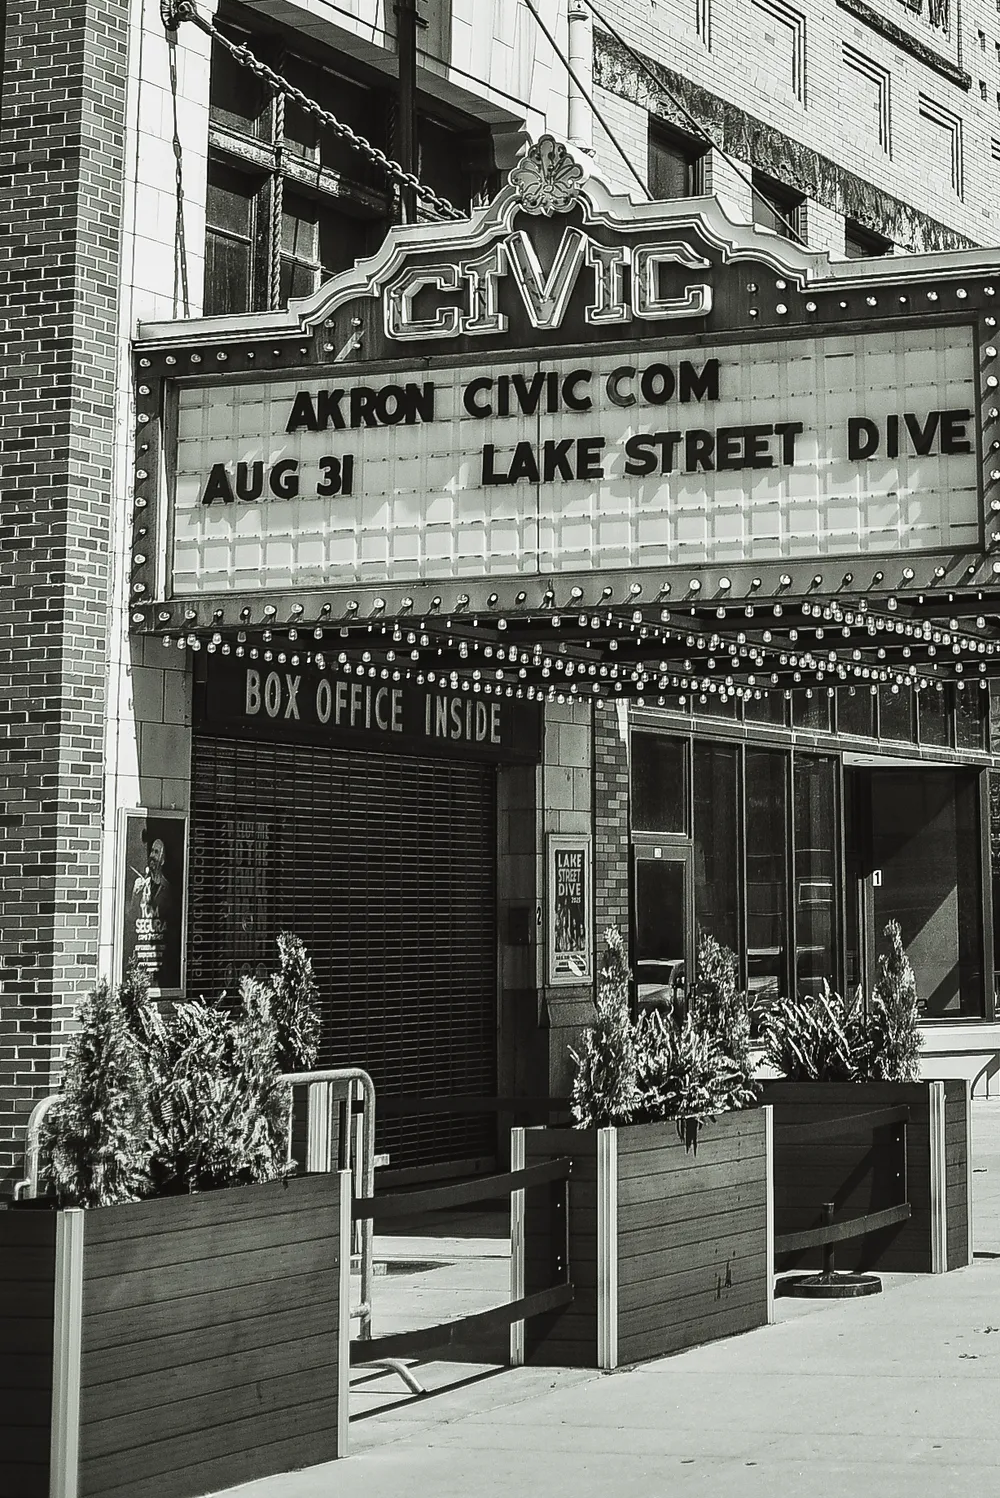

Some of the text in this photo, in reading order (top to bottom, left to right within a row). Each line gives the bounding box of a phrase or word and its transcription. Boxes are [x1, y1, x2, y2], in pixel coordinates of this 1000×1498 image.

[384, 226, 712, 340] CIVIC
[285, 358, 719, 432] AKRON CIVIC COM
[482, 409, 971, 486] LAKE STREET DIVE
[202, 454, 354, 505] AUG 31
[245, 668, 501, 743] BOX OFFICE INSIDE
[558, 853, 582, 868] LAKE
[558, 868, 581, 883] STREET
[558, 882, 581, 896] DIVE
[140, 903, 160, 919] TOM
[536, 906, 542, 926] 2
[135, 918, 168, 934] SEGURA
